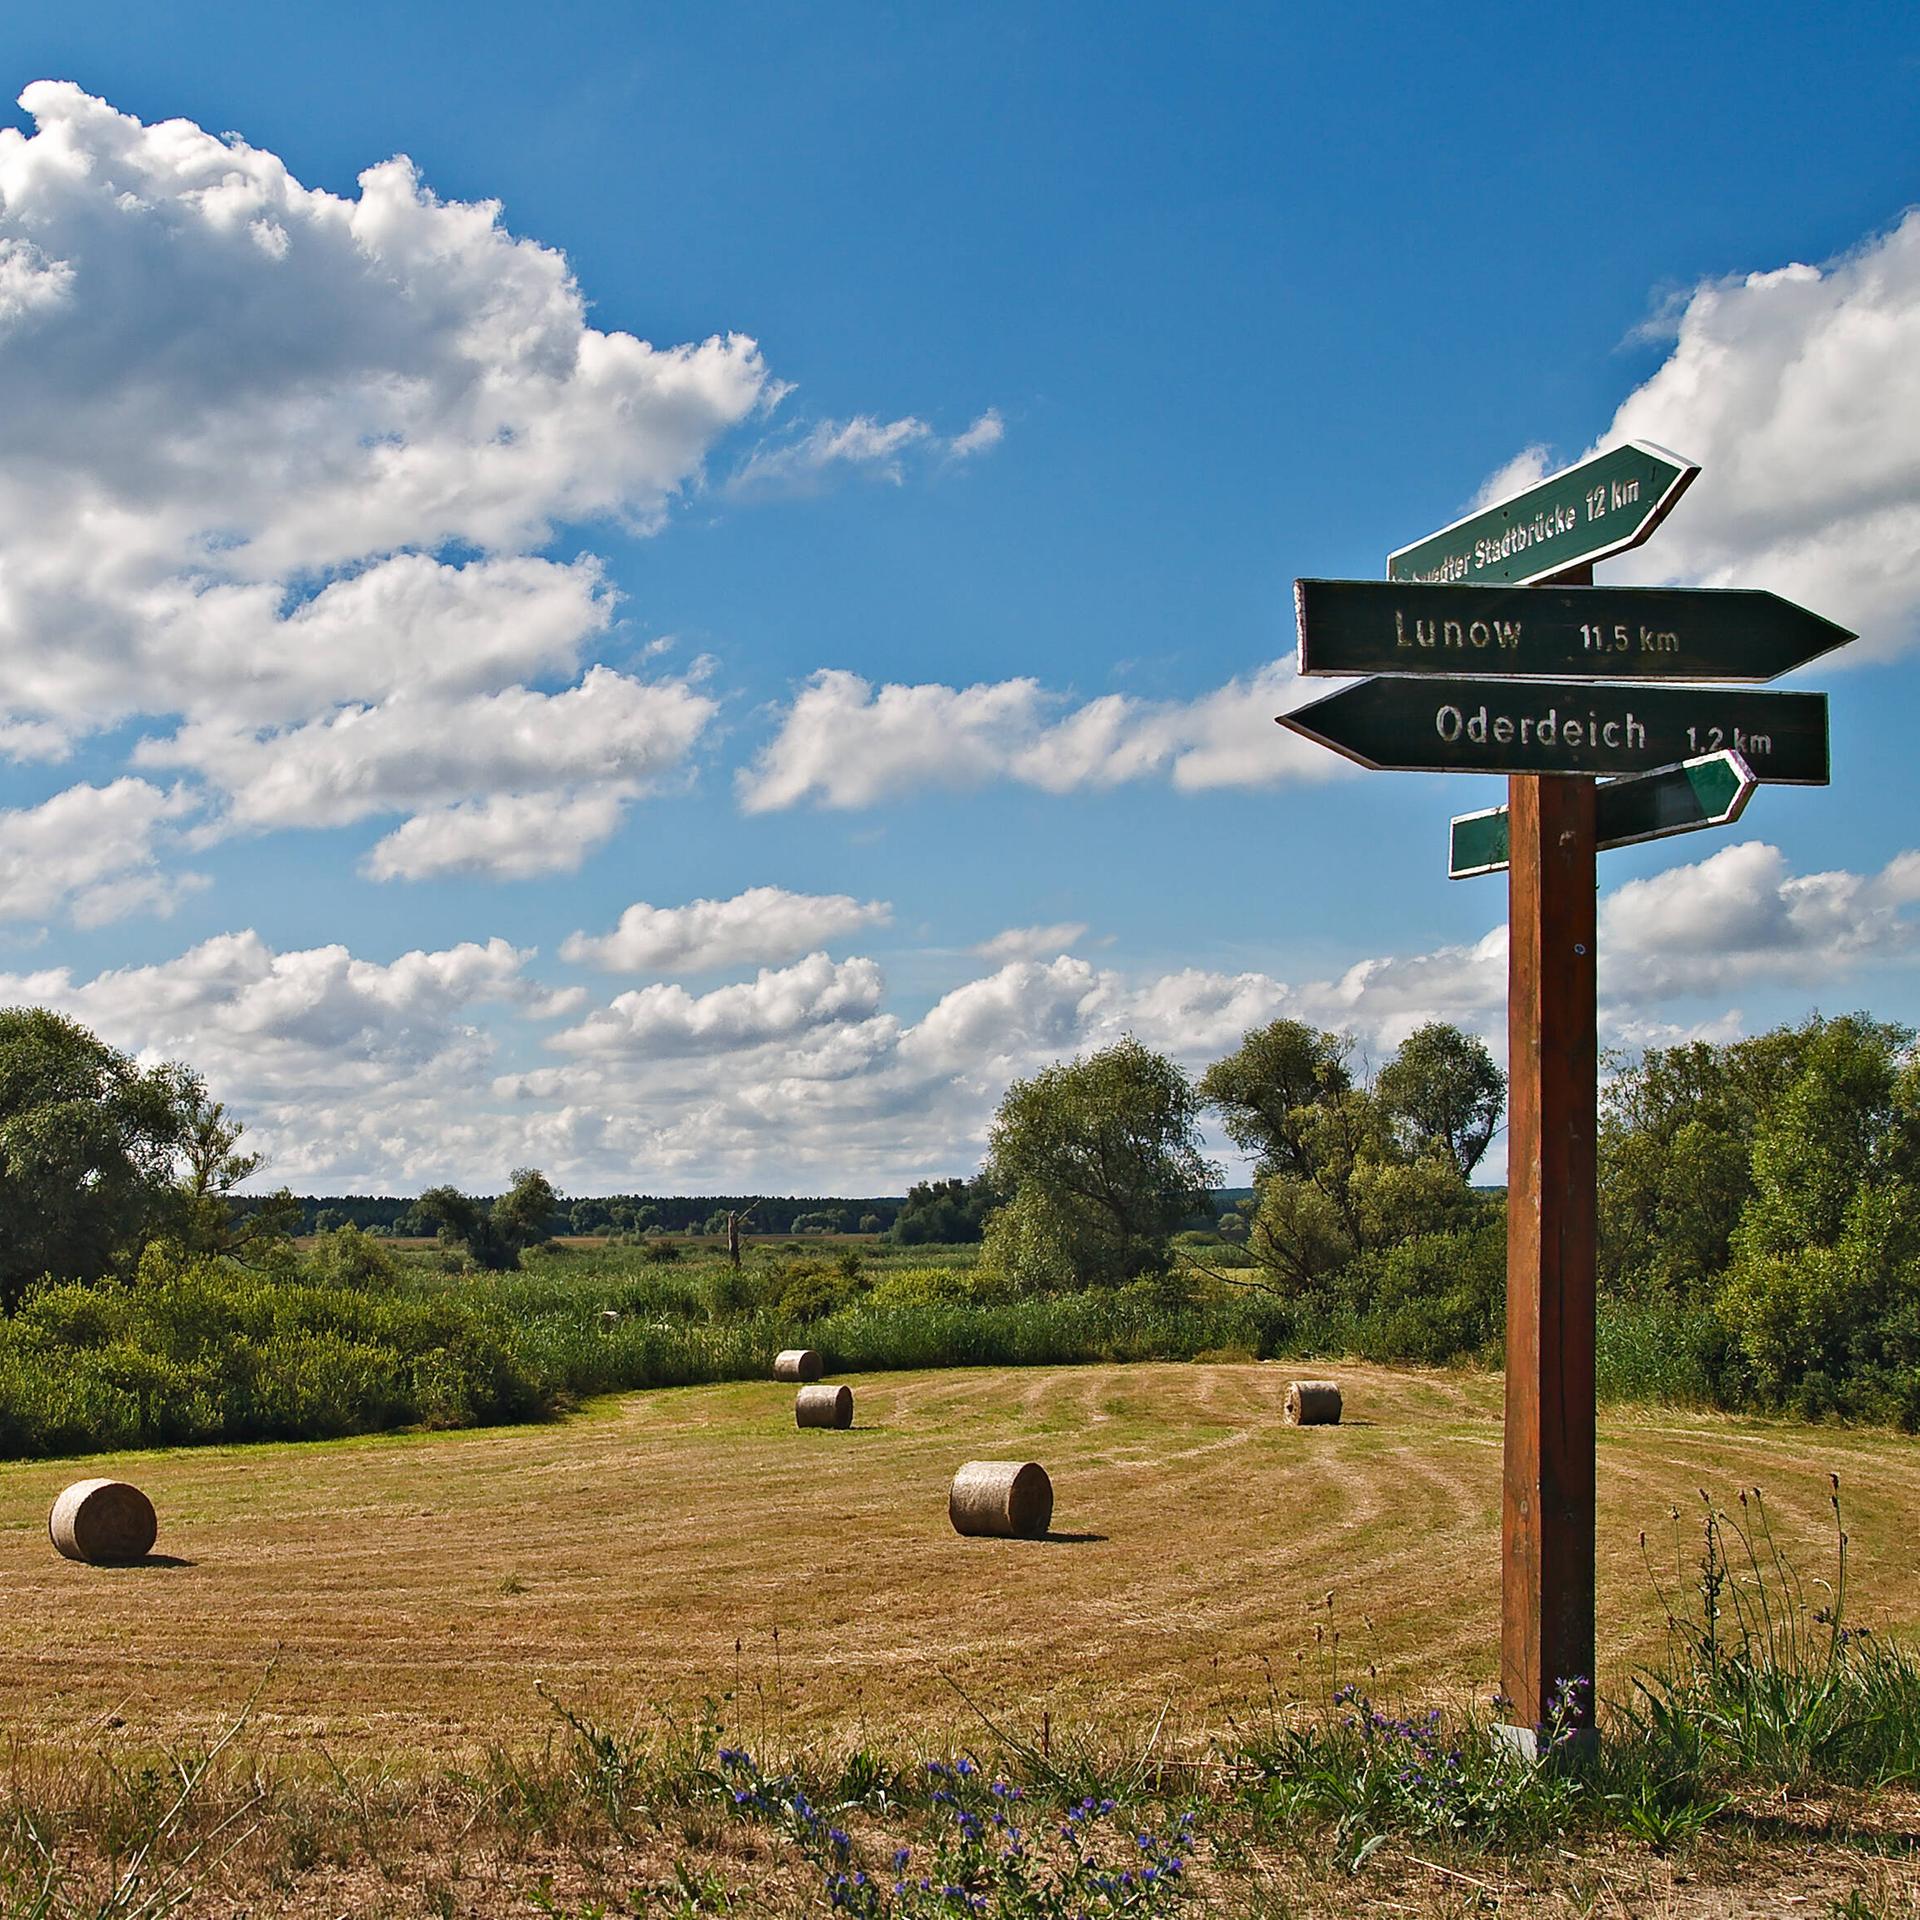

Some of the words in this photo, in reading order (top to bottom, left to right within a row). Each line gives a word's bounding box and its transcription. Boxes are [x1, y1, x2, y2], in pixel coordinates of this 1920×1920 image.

[1474, 503, 1576, 569] Stadtbrücke
[1585, 484, 1606, 522] 12
[1611, 478, 1640, 512] km
[1394, 611, 1523, 649] Lunow
[1639, 626, 1680, 653] km
[1436, 704, 1647, 750] Oderdeich
[1734, 728, 1772, 755] km
